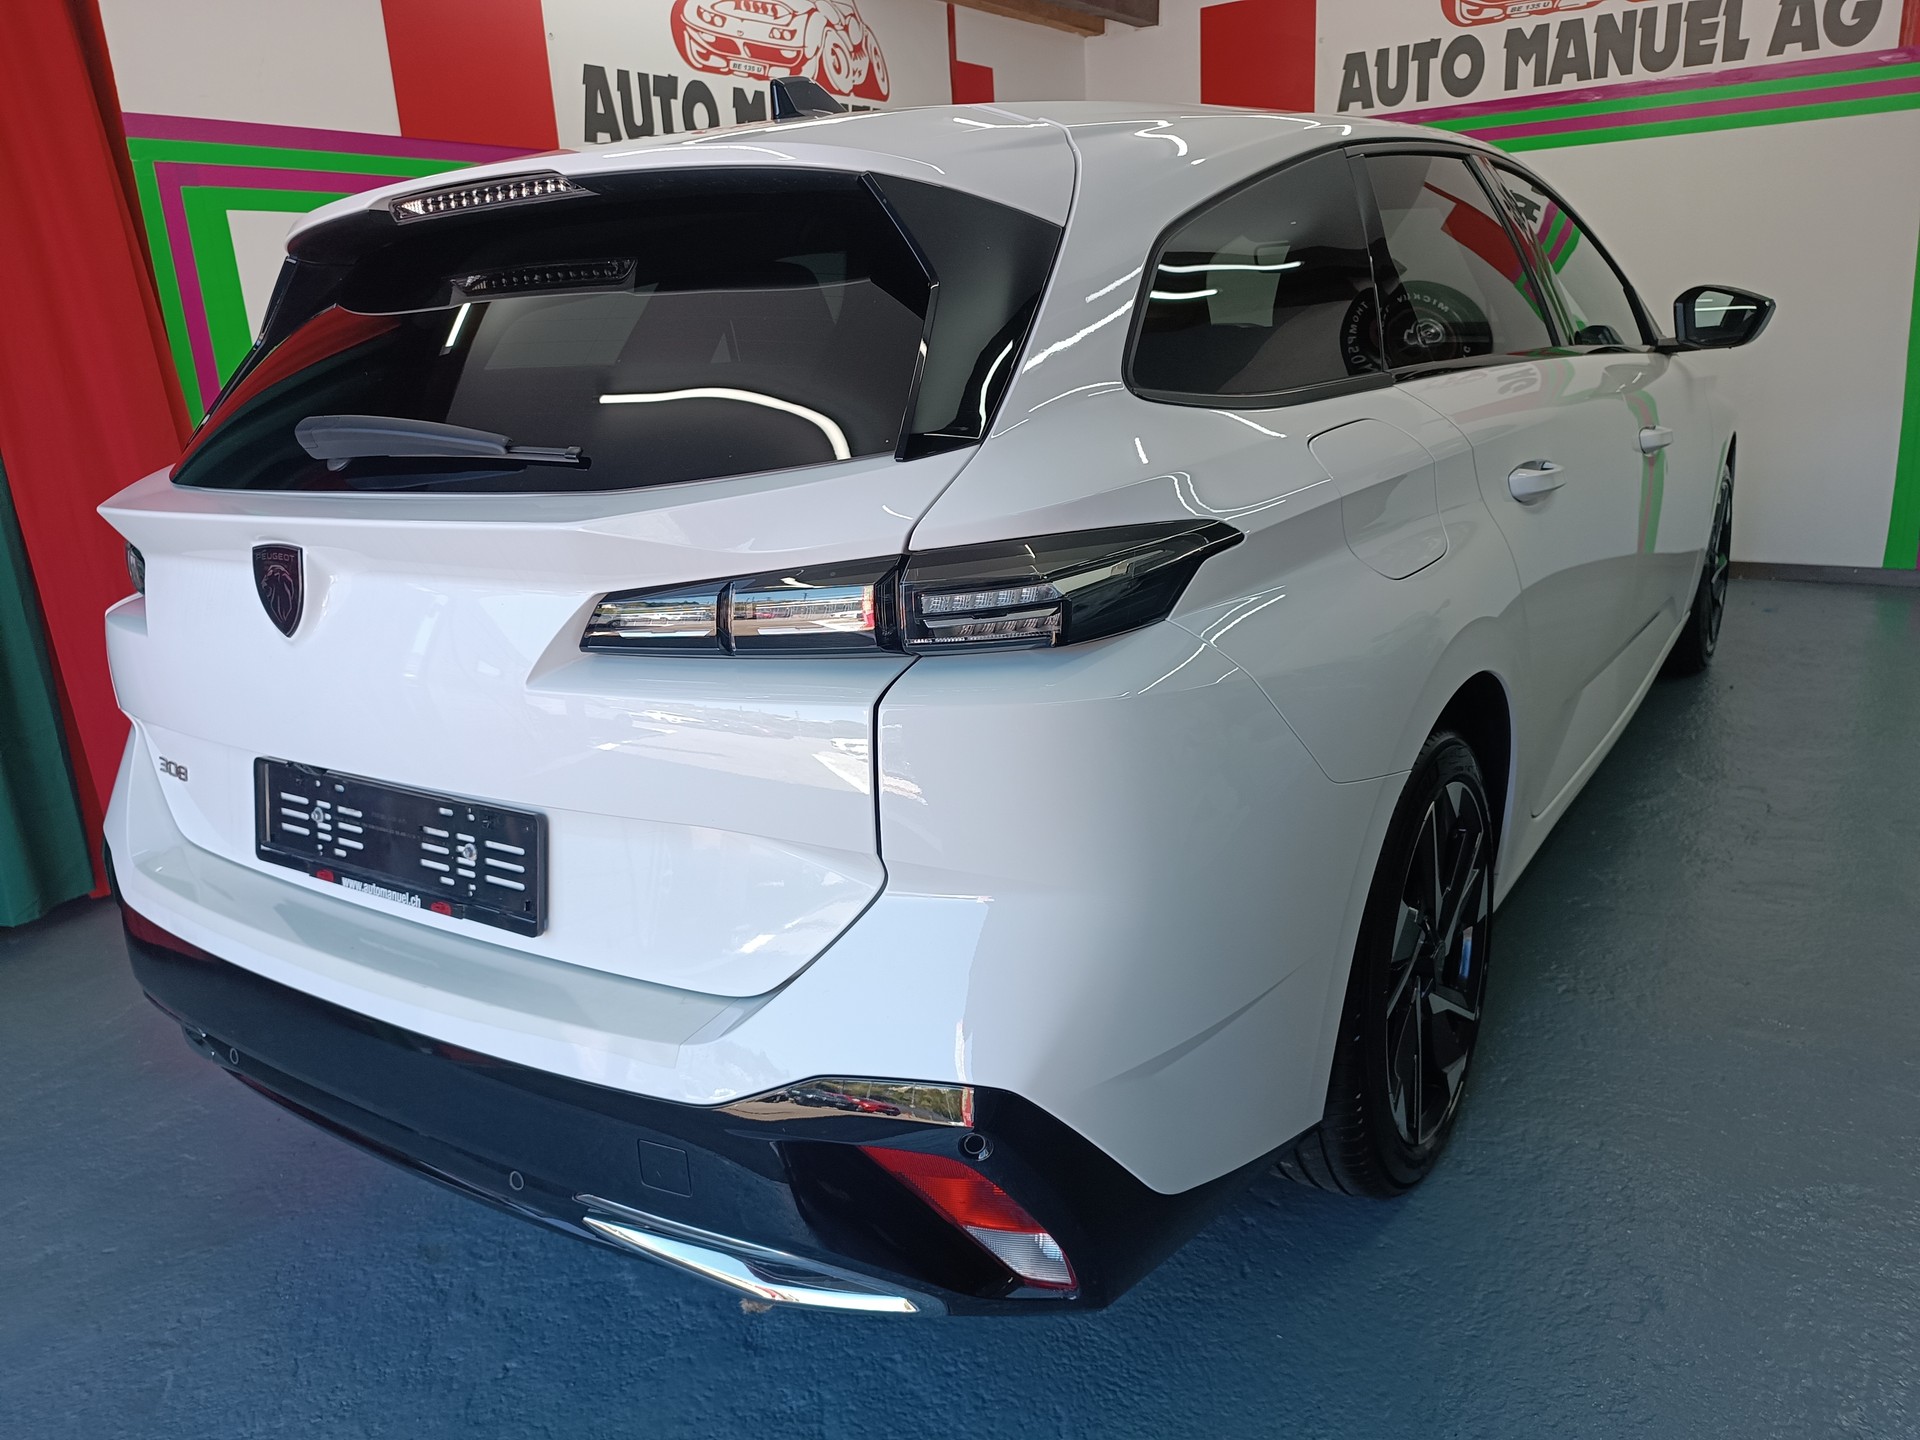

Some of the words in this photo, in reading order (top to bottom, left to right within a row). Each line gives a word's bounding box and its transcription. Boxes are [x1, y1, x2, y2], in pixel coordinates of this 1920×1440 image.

[732, 62, 742, 70] BE
[1337, 34, 1485, 112] AUTO
[1503, 0, 1749, 91] MANUEL
[1766, 0, 1883, 57] AG
[583, 64, 720, 143] AUTO
[255, 551, 295, 562] PEUGEOT
[159, 756, 188, 782] 308
[341, 876, 422, 909] www.automanuel.ch
